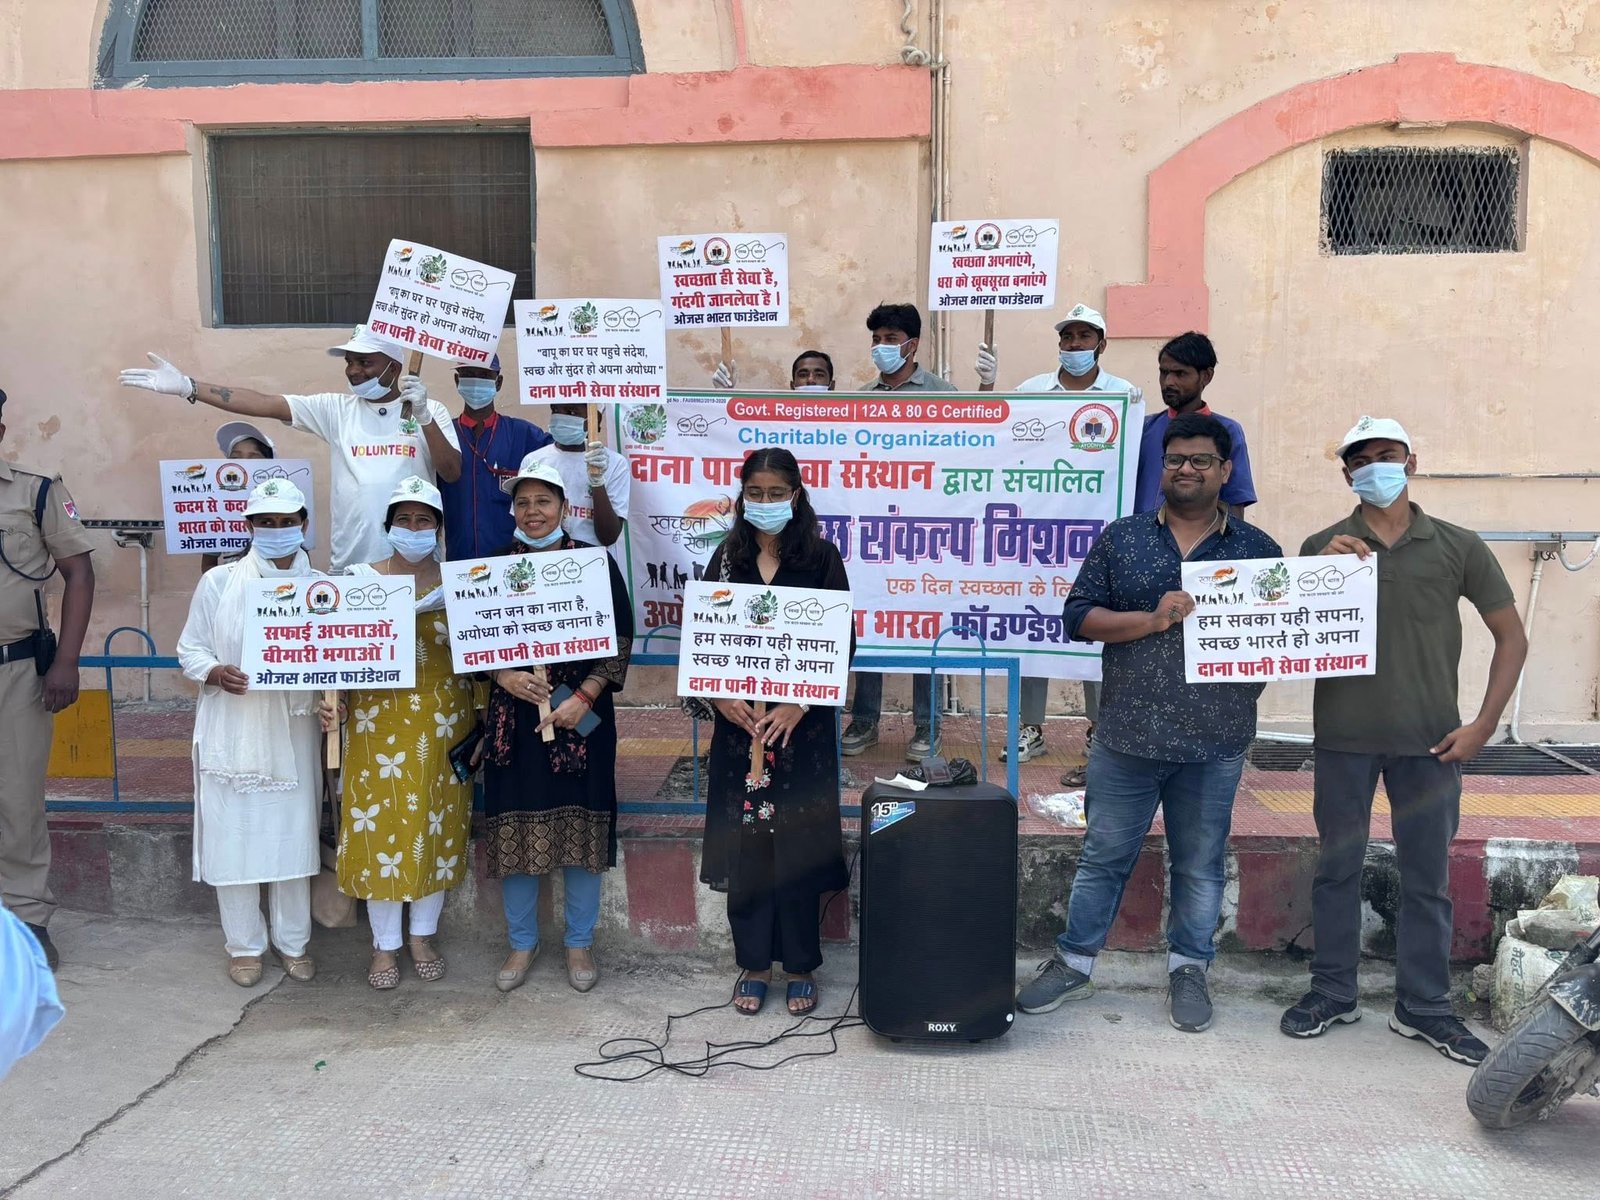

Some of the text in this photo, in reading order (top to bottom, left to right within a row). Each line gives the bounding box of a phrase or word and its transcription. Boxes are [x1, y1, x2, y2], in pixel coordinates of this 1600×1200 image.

[952, 252, 1036, 269] स्वच्छता अपनाएंगे,
[673, 268, 778, 288] स्वच्छता ही सेवा है,
[938, 271, 1048, 292] धरा को खूबसूरत बनाएंगे
[400, 289, 410, 300] का
[412, 291, 423, 304] घर
[425, 296, 438, 309] घर
[440, 301, 460, 315] पहुचे
[461, 306, 486, 324] संदेश,
[671, 291, 705, 309] गंदगी
[707, 290, 760, 307] जानलेवा
[761, 289, 771, 306] है
[939, 292, 1044, 306] ओजस भारत फाउंडेशन
[388, 302, 399, 315] और
[401, 307, 418, 321] सुंदर
[421, 310, 431, 325] हो
[432, 316, 458, 333] अपना
[459, 322, 490, 342] अयोध्या
[674, 309, 778, 325] ओजस भारत फाउंडेशन
[371, 319, 489, 362] दाना पानी सेवा संस्थान
[559, 347, 571, 357] का
[572, 347, 584, 357] घर
[586, 347, 598, 357] घर
[601, 344, 621, 360] पहुचे
[622, 344, 648, 359] संदेश,
[523, 366, 545, 377] स्वच्छ
[548, 362, 563, 376] और
[565, 363, 584, 378] सुंदर
[586, 361, 596, 375] हो
[598, 365, 623, 375] अपना
[625, 362, 657, 375] अयोध्या
[529, 381, 661, 399] दाना पानी सेवा संस्थान
[734, 402, 771, 416] Govt.
[775, 402, 848, 419] Registered
[862, 404, 888, 417] 12A
[891, 404, 902, 417] &
[906, 404, 922, 417] 80
[926, 404, 938, 417] G
[942, 403, 1002, 418] Certified
[738, 427, 995, 450] Charitable Organization
[351, 445, 417, 458] VOLUNTEER
[629, 454, 694, 484] दाना
[840, 452, 935, 490] संस्थान
[942, 468, 994, 496] द्वारा
[1002, 458, 1105, 494] संचालित
[173, 500, 204, 513] कदम
[206, 497, 218, 513] से
[178, 521, 207, 534] भारत
[209, 516, 226, 533] को
[648, 515, 709, 536] स्वच्छता
[859, 504, 977, 565] संकल्प
[983, 502, 1106, 567] मिशन
[180, 537, 250, 549] ओजस भारत
[672, 531, 682, 543] ही
[684, 533, 712, 554] सेवा
[886, 573, 1073, 597] एक दिन स्वच्छता के लि
[505, 605, 524, 619] जन
[527, 603, 544, 616] का
[547, 600, 572, 613] नारा
[575, 595, 589, 611] है,
[457, 625, 499, 641] अयोध्या
[503, 621, 519, 636] को
[522, 621, 553, 634] स्वच्छ
[556, 616, 592, 630] बनाना
[874, 609, 944, 640] भारत
[951, 604, 1093, 645] फॉउण्डेश
[1197, 606, 1364, 630] हम सबका यही सपना,
[263, 619, 398, 641] सफाई अपनाओं,
[1198, 636, 1241, 651] स्वच्छ
[1292, 628, 1310, 648] हो
[1315, 629, 1360, 645] अपना
[262, 645, 319, 663] बीमारी
[322, 643, 384, 662] भगाओं
[463, 636, 610, 666] दाना पानी सेवा संस्थान
[693, 632, 839, 655] हम सबका यही सपना,
[692, 653, 834, 674] स्वच्छ भारत हो अपना
[1197, 653, 1368, 677] दाना पानी सेवा संस्थान
[256, 667, 401, 685] ओजस भारत फाउंडेशन
[689, 676, 840, 700] दाना पानी सेवा संस्थान
[928, 1023, 955, 1032] ROXY
